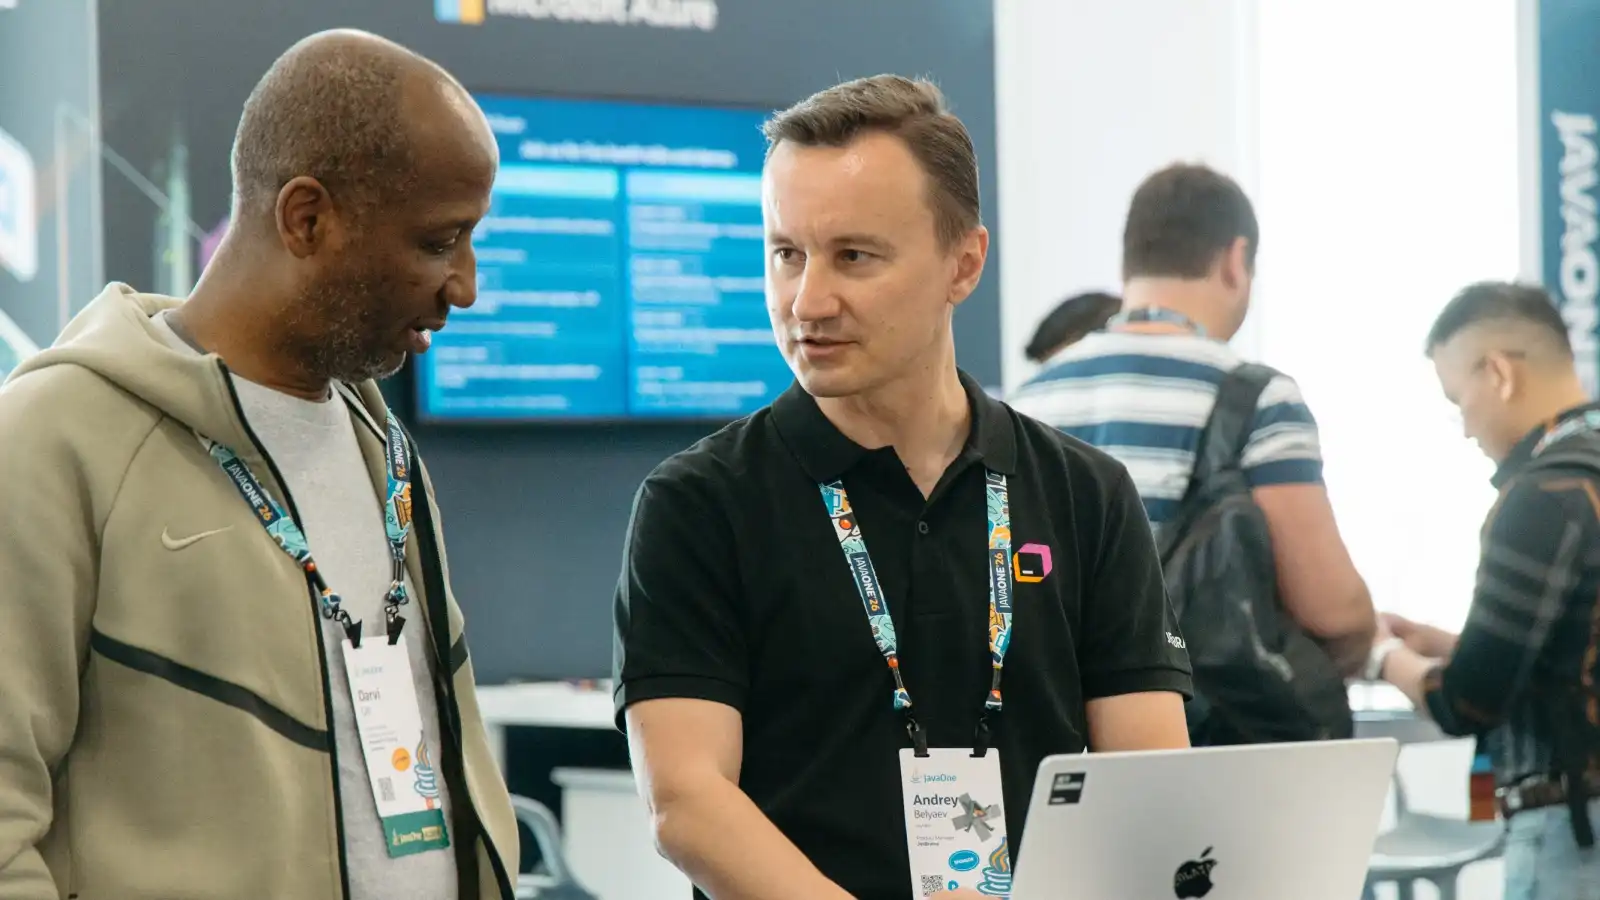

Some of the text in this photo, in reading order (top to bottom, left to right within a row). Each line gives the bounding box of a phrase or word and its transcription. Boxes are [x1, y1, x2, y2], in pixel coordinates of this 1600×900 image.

[228, 463, 264, 511] JAVAONE
[853, 556, 876, 598] JAVAONE
[996, 567, 1011, 609] JAVAONE
[913, 793, 958, 808] Andrey
[914, 809, 948, 821] Belyaev
